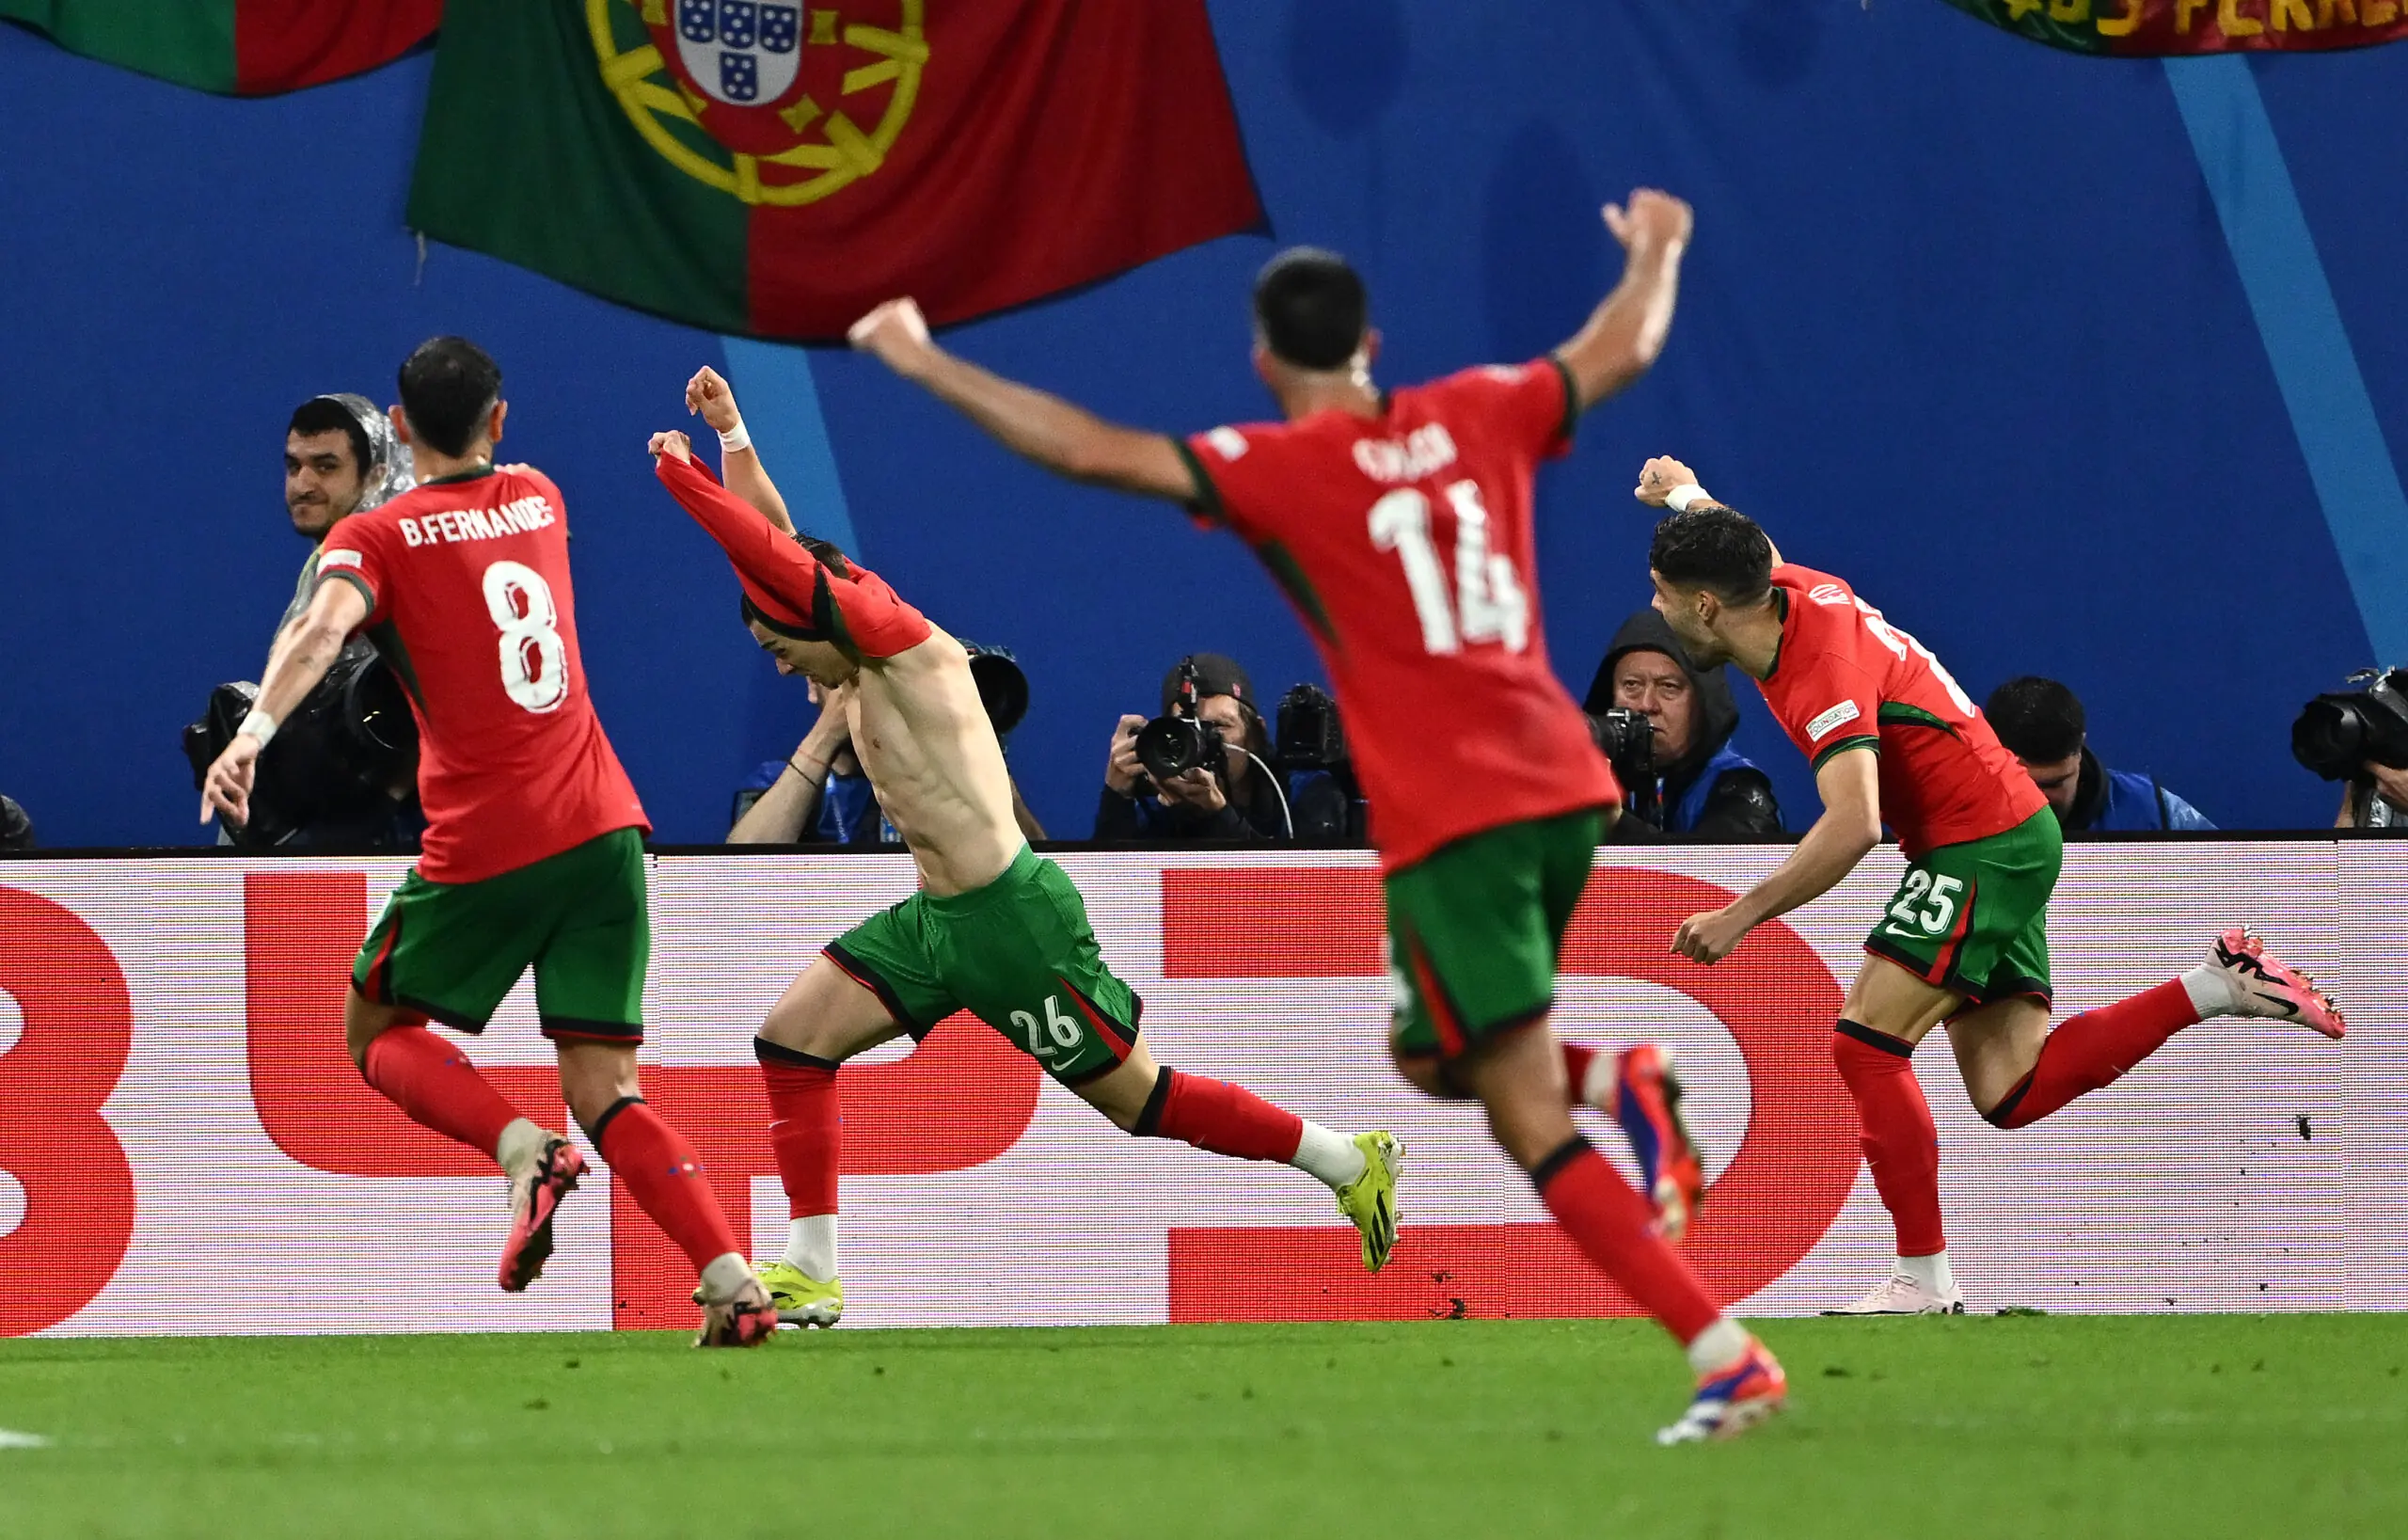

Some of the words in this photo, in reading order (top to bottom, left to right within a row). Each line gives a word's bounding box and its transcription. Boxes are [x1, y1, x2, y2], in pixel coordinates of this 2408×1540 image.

[1368, 479, 1529, 655] 14
[482, 560, 568, 714] 8
[1891, 868, 1963, 935] 25
[1009, 994, 1084, 1057] 26
